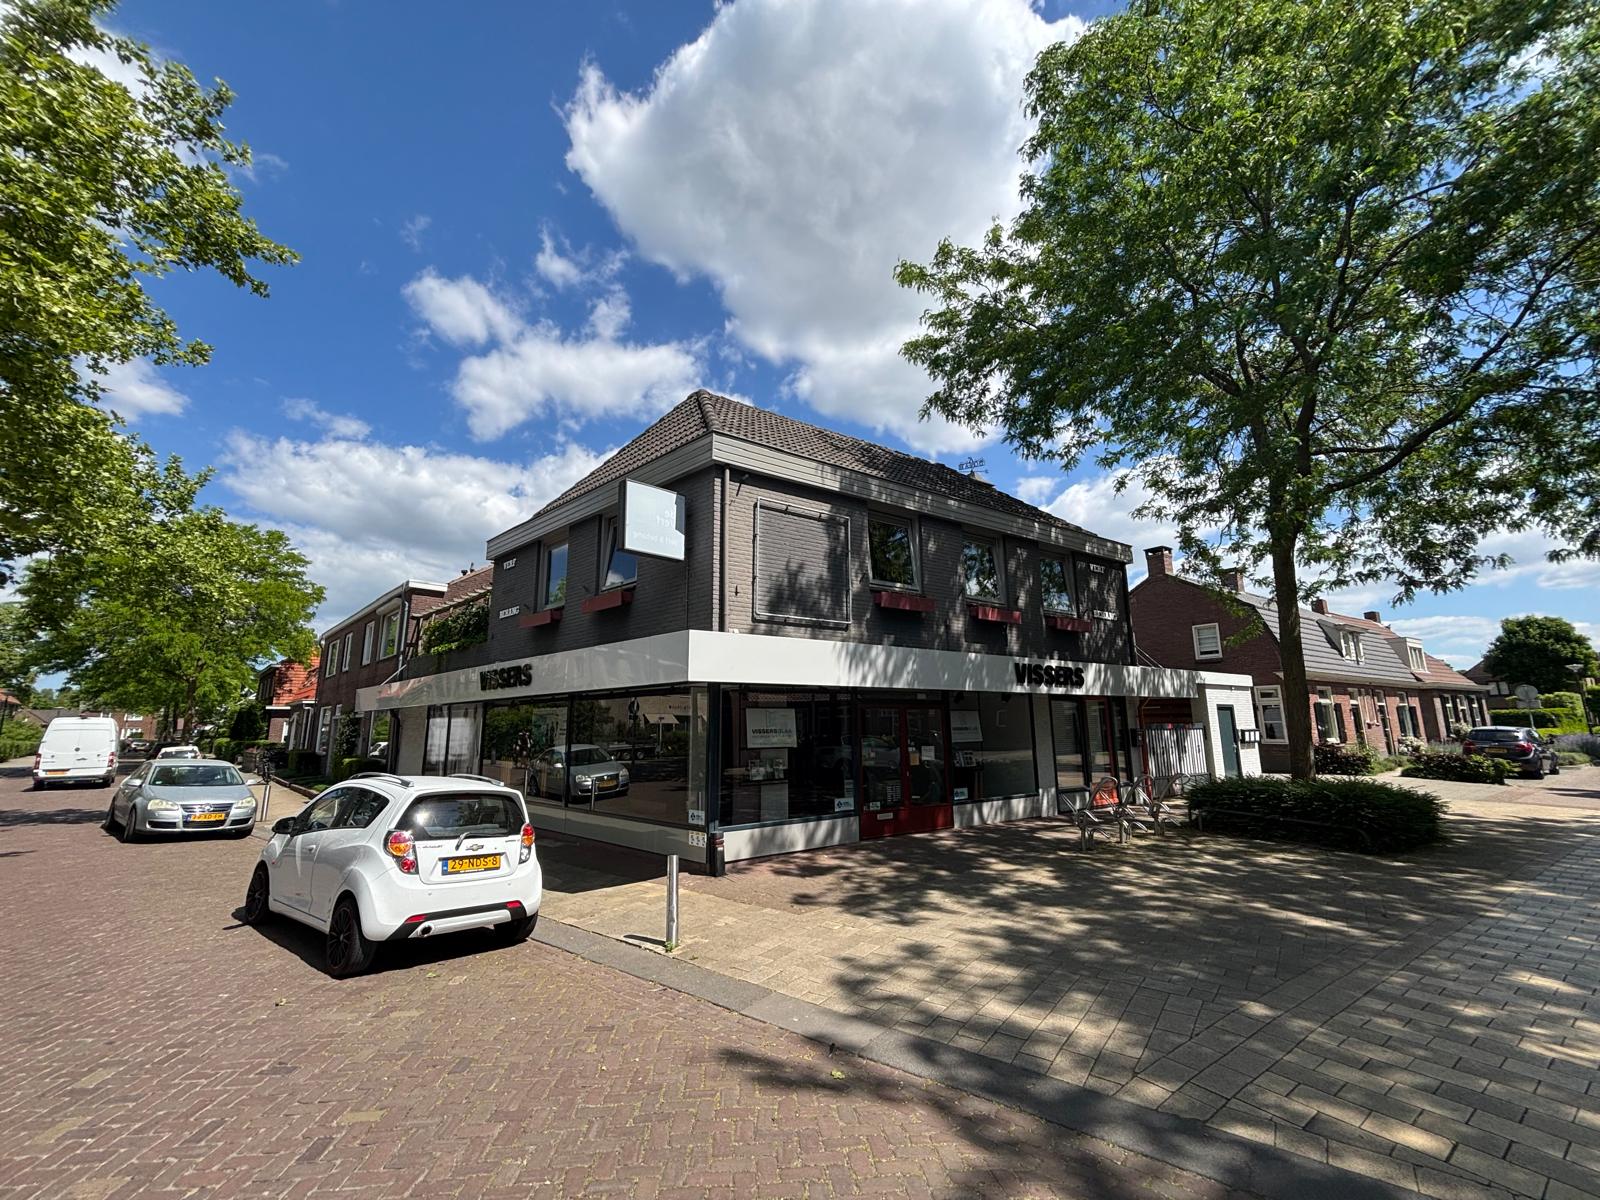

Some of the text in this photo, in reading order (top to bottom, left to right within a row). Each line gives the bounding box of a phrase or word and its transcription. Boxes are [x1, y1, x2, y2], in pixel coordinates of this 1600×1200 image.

[480, 664, 532, 691] VISSERS
[1014, 662, 1085, 688] VISSERS
[451, 856, 498, 870] 29-NDS-8
